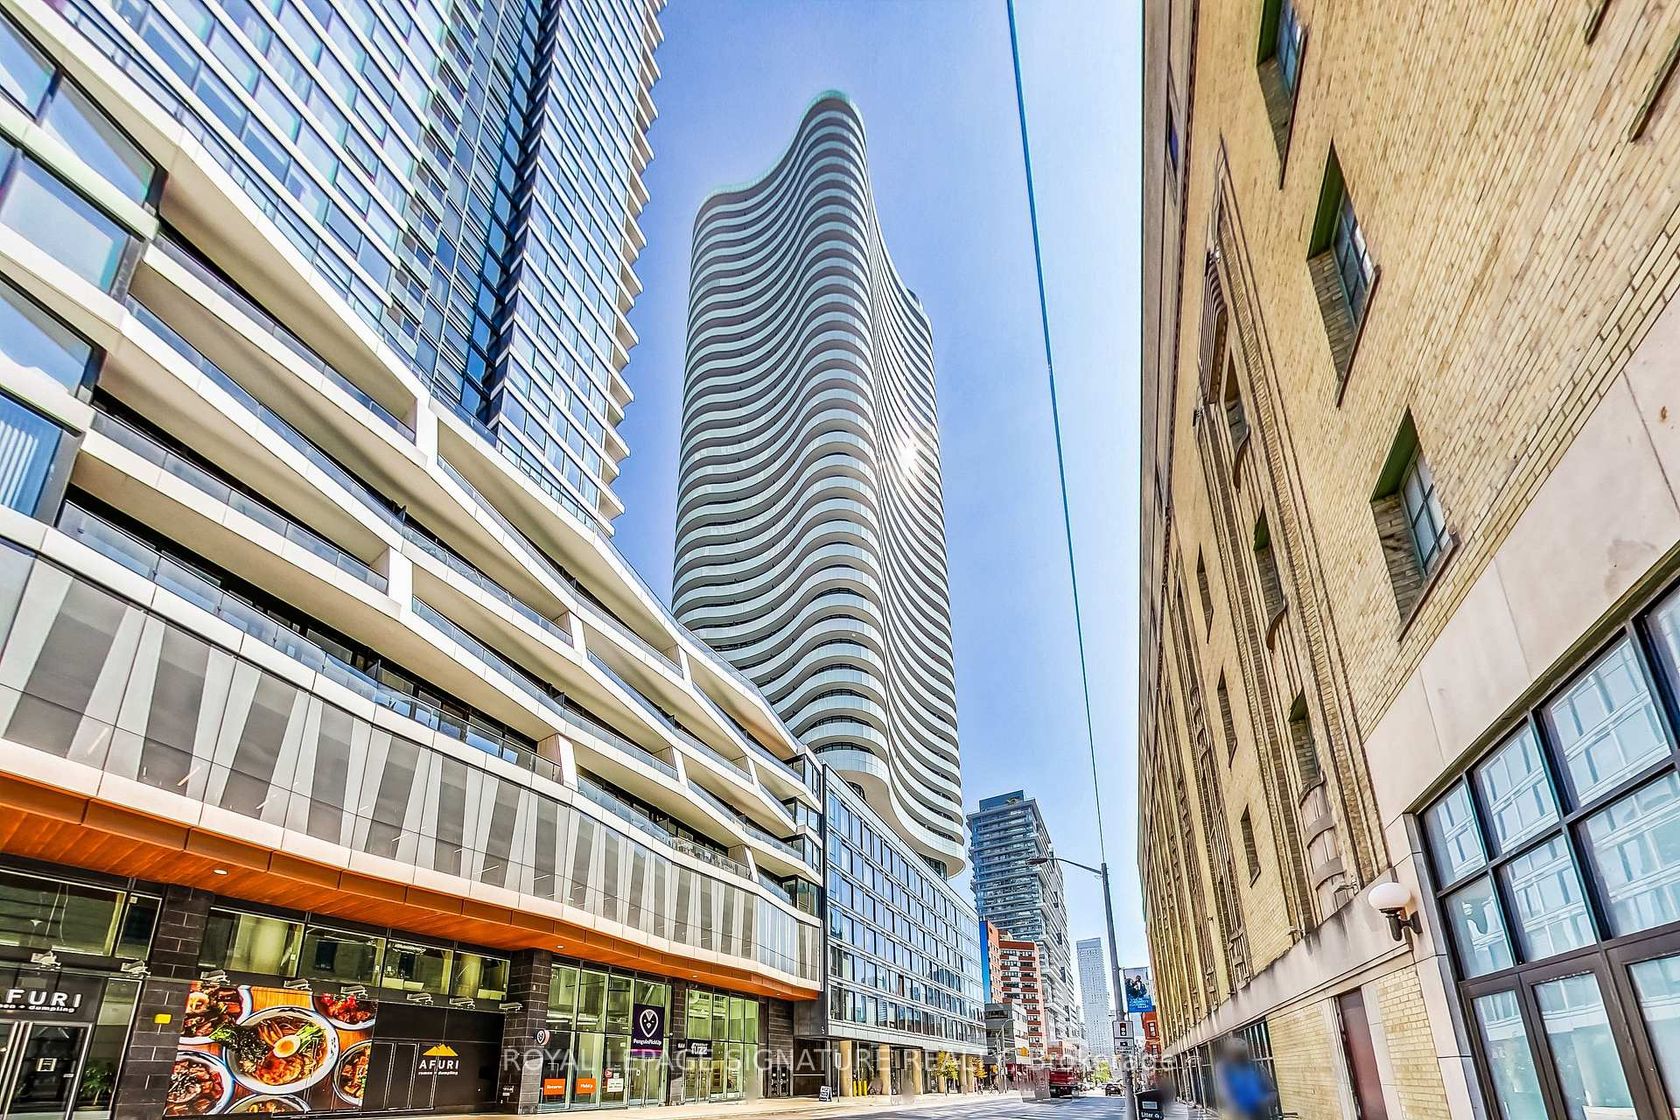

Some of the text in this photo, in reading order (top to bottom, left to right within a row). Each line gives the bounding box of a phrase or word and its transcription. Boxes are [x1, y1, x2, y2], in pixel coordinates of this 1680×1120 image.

[6, 988, 82, 1008] FURI
[28, 1005, 75, 1013] dumpling
[691, 1042, 708, 1055] fuzz
[418, 1059, 460, 1070] AFURI
